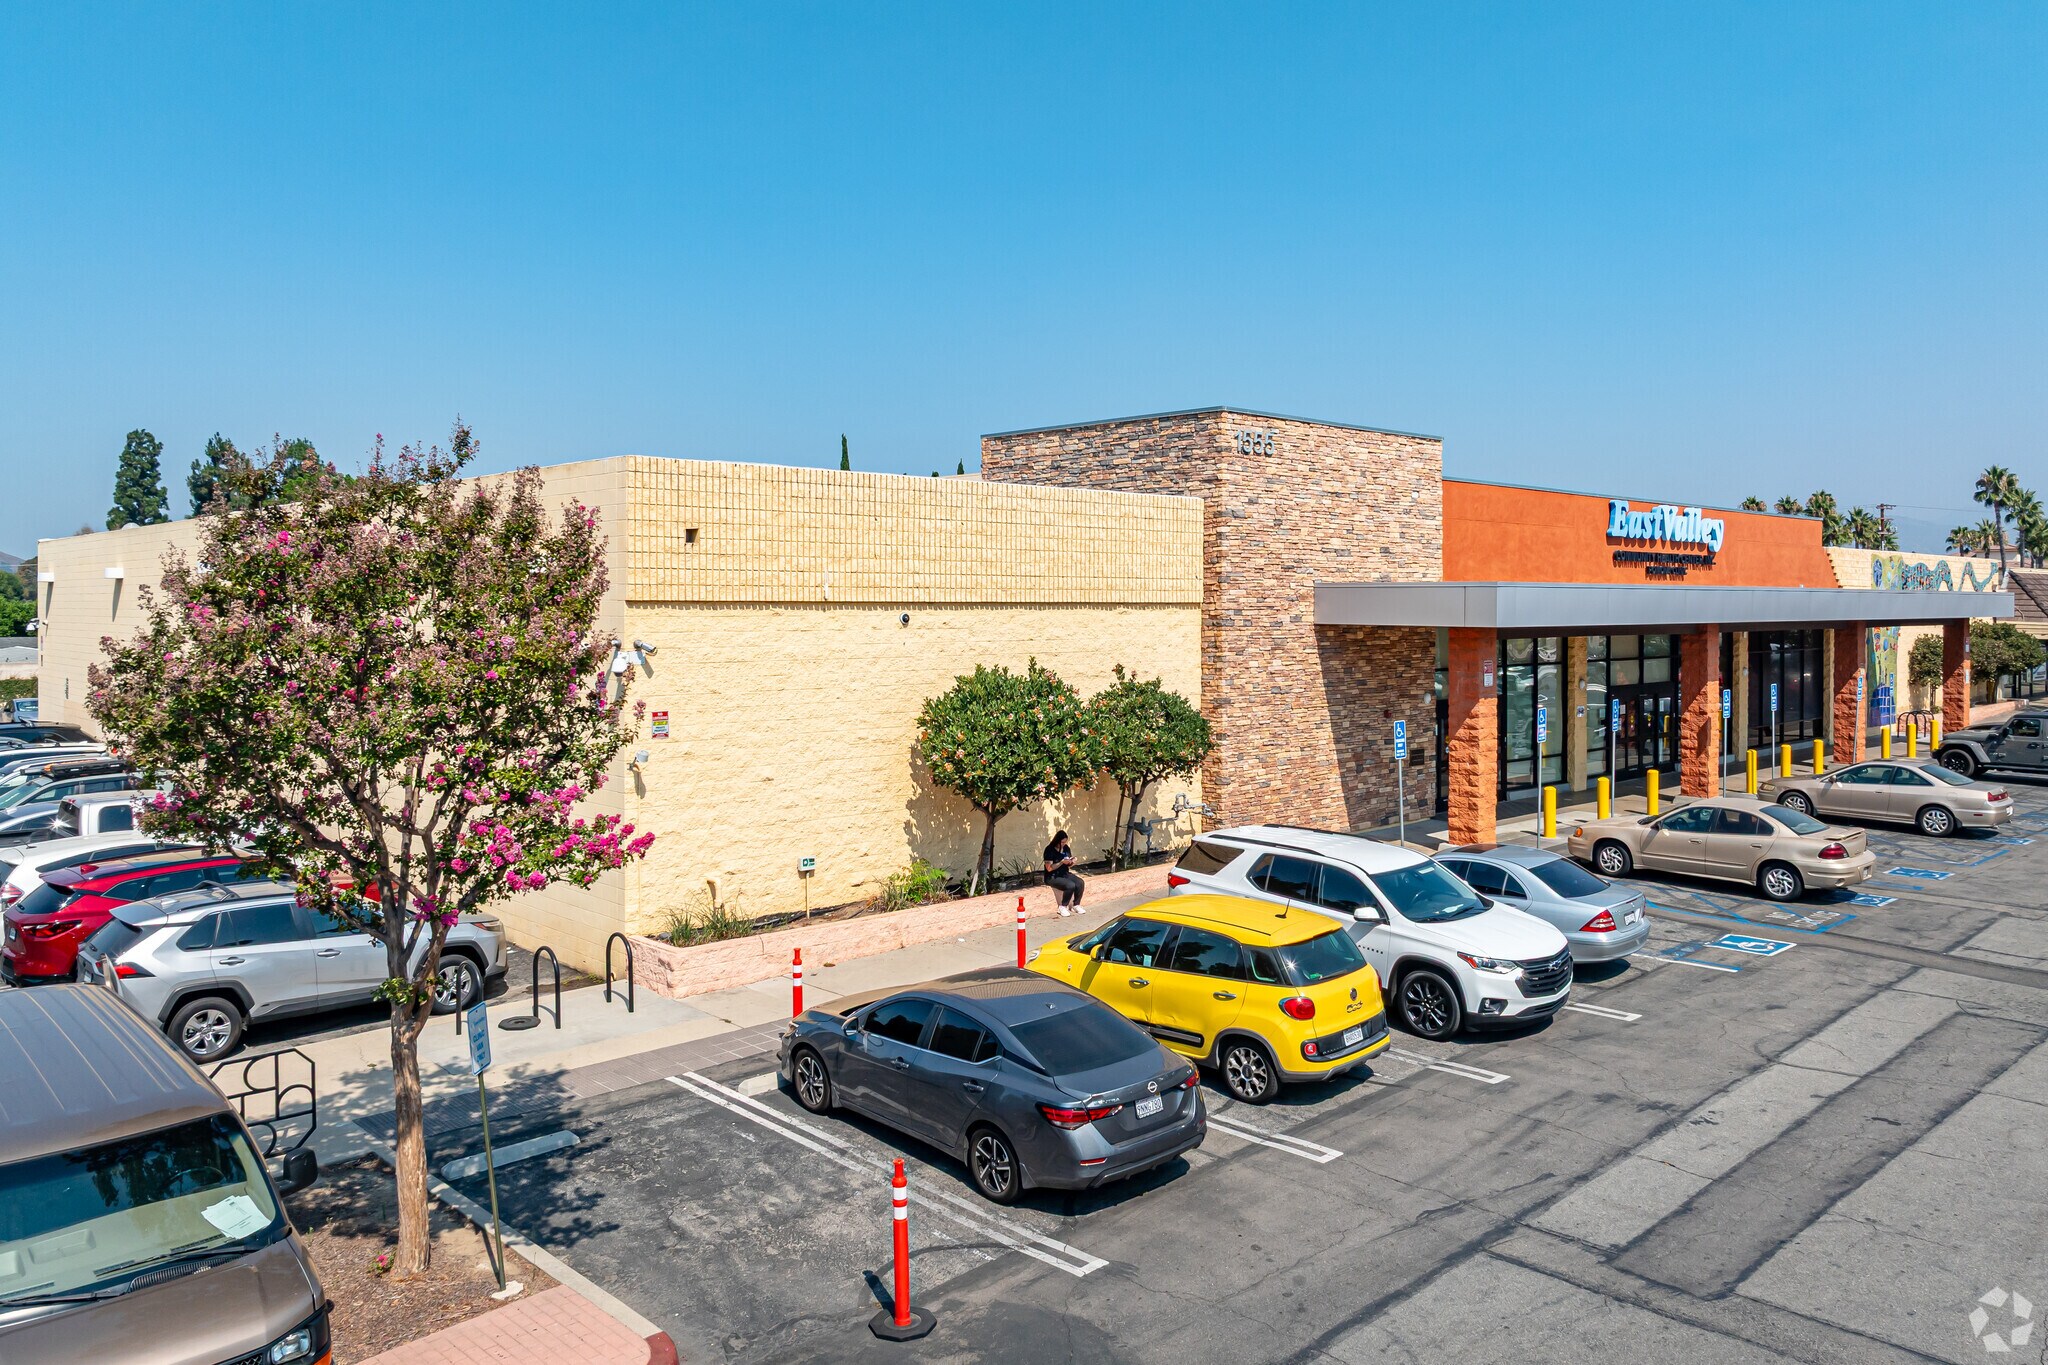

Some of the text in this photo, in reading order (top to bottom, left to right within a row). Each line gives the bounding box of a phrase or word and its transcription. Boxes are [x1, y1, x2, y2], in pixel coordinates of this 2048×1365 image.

[1234, 429, 1275, 456] 1555
[1607, 500, 1724, 552] East Valley
